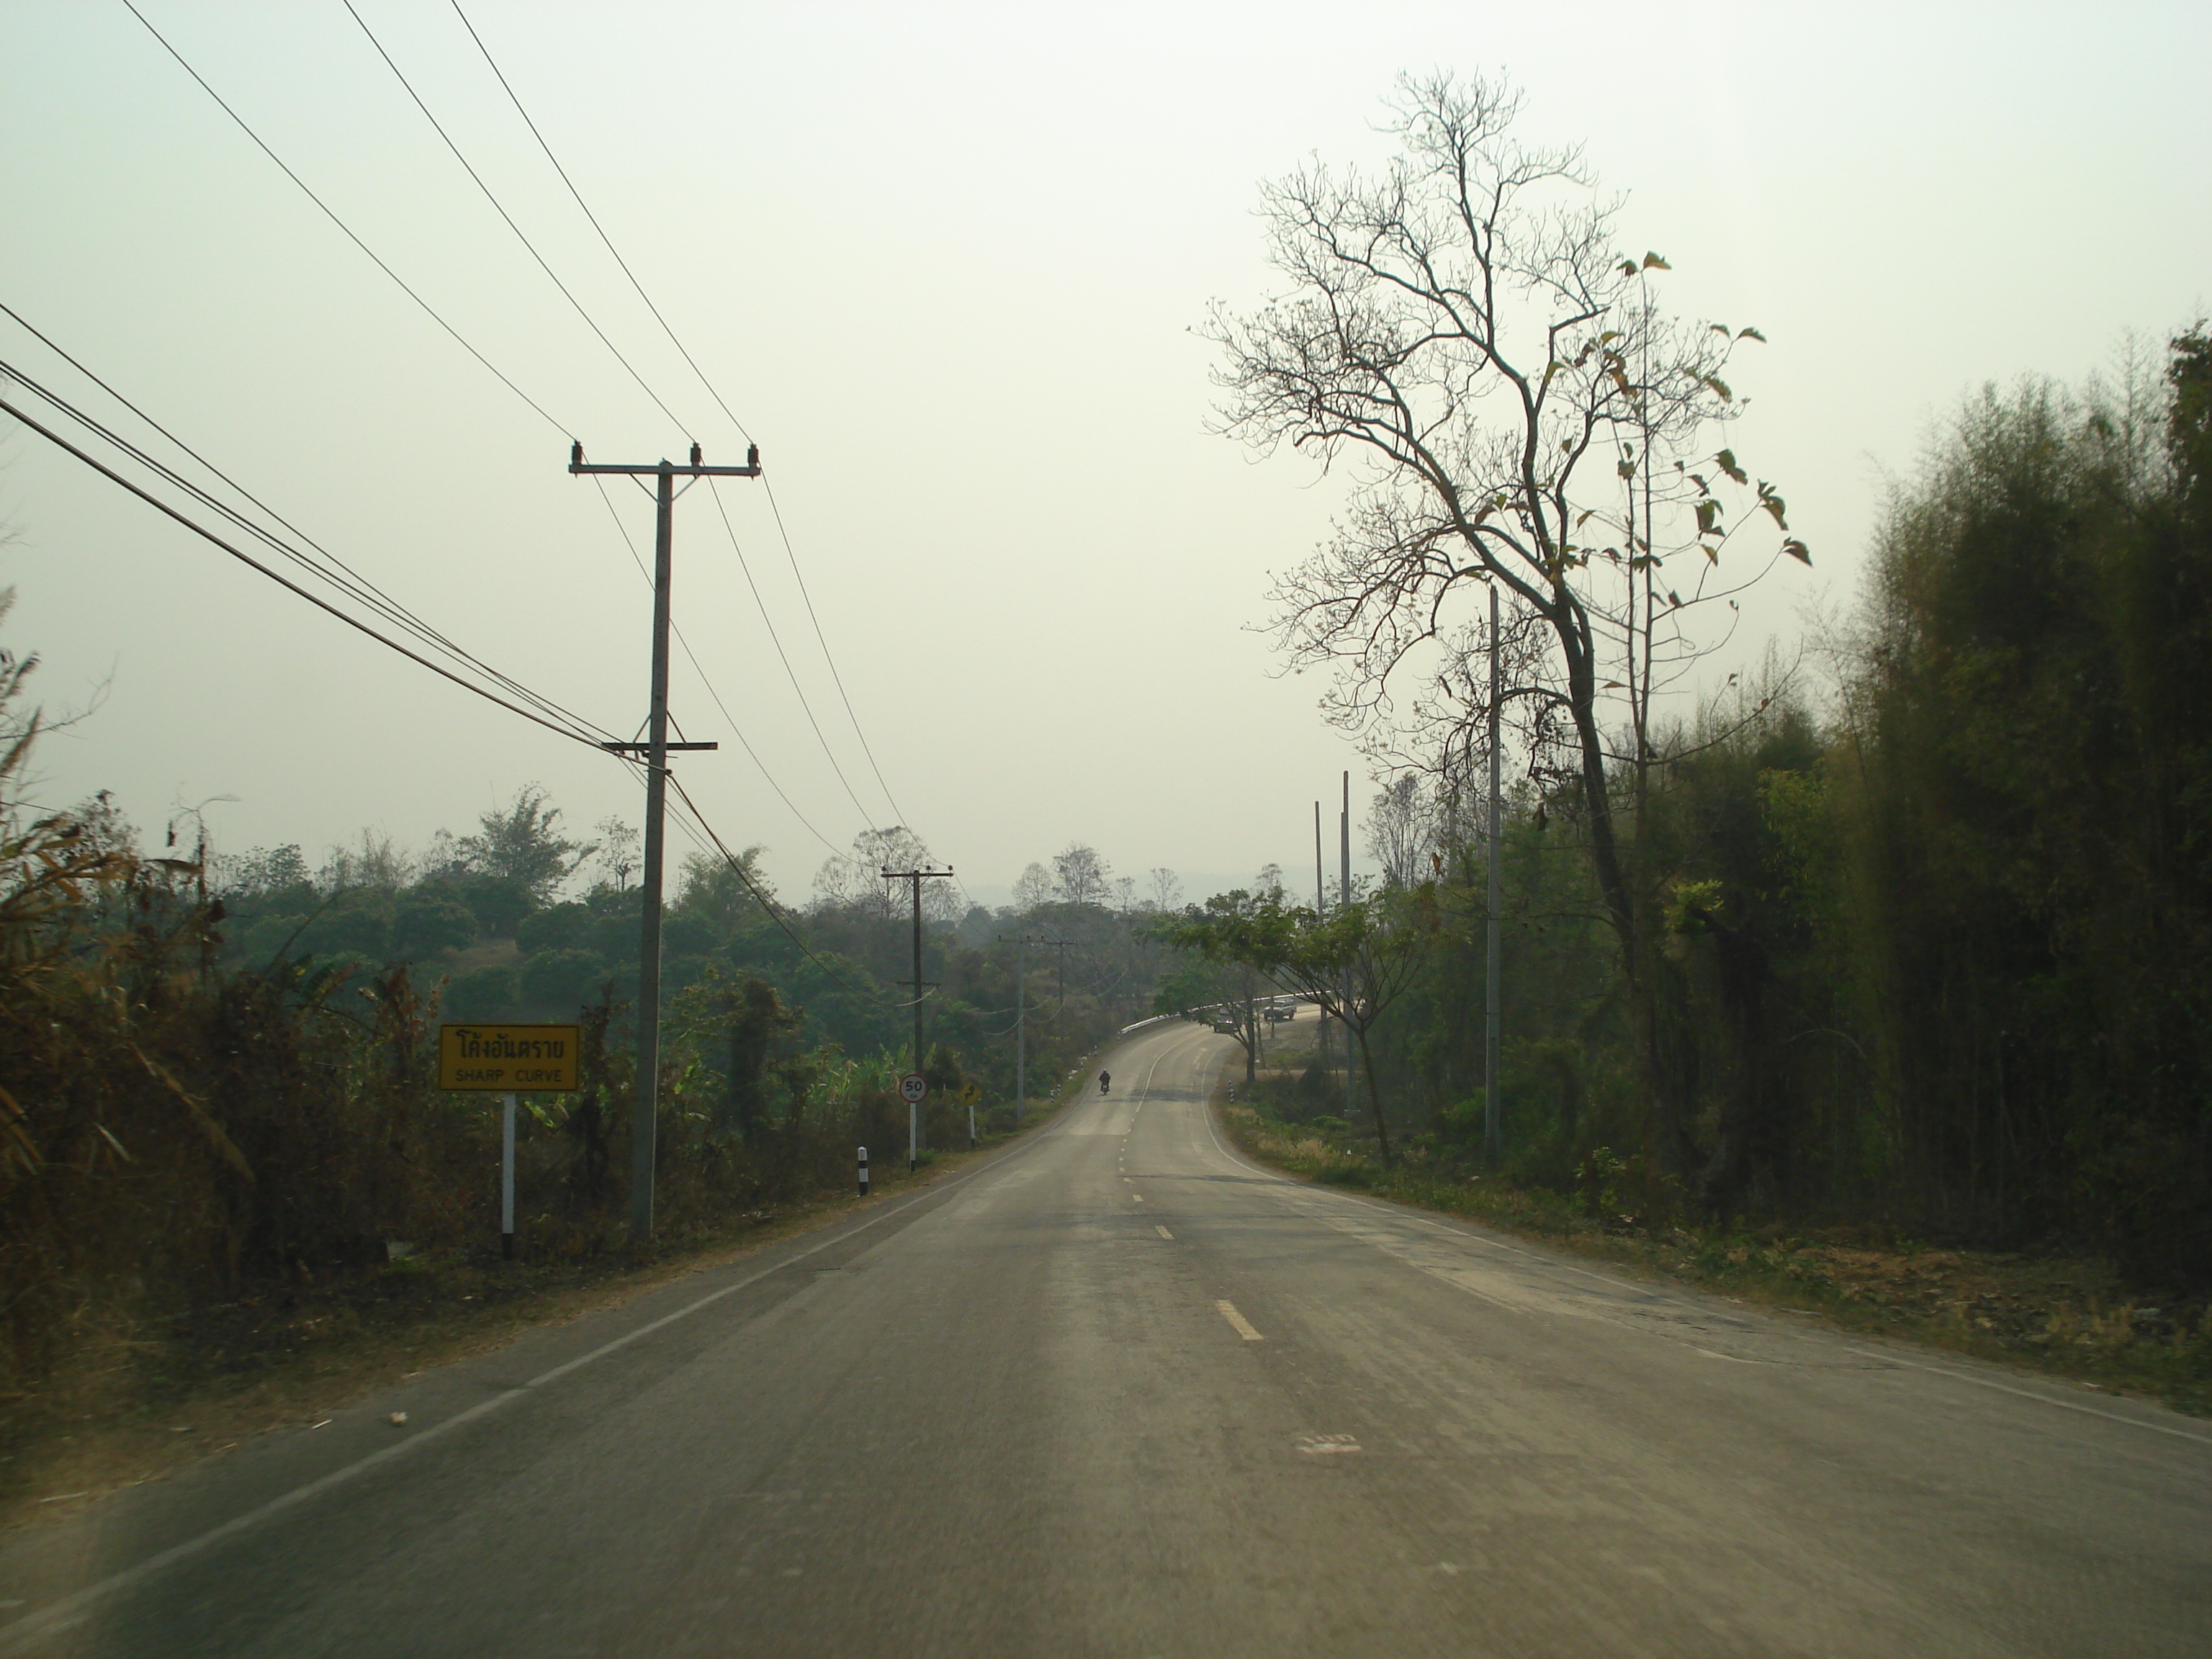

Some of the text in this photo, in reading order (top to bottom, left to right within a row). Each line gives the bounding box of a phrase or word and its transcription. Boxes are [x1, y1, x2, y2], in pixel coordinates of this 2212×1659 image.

[456, 1029, 564, 1058] โค้งอันตราย
[456, 1069, 562, 1082] SHARP CURVE
[907, 1082, 922, 1091] 50
